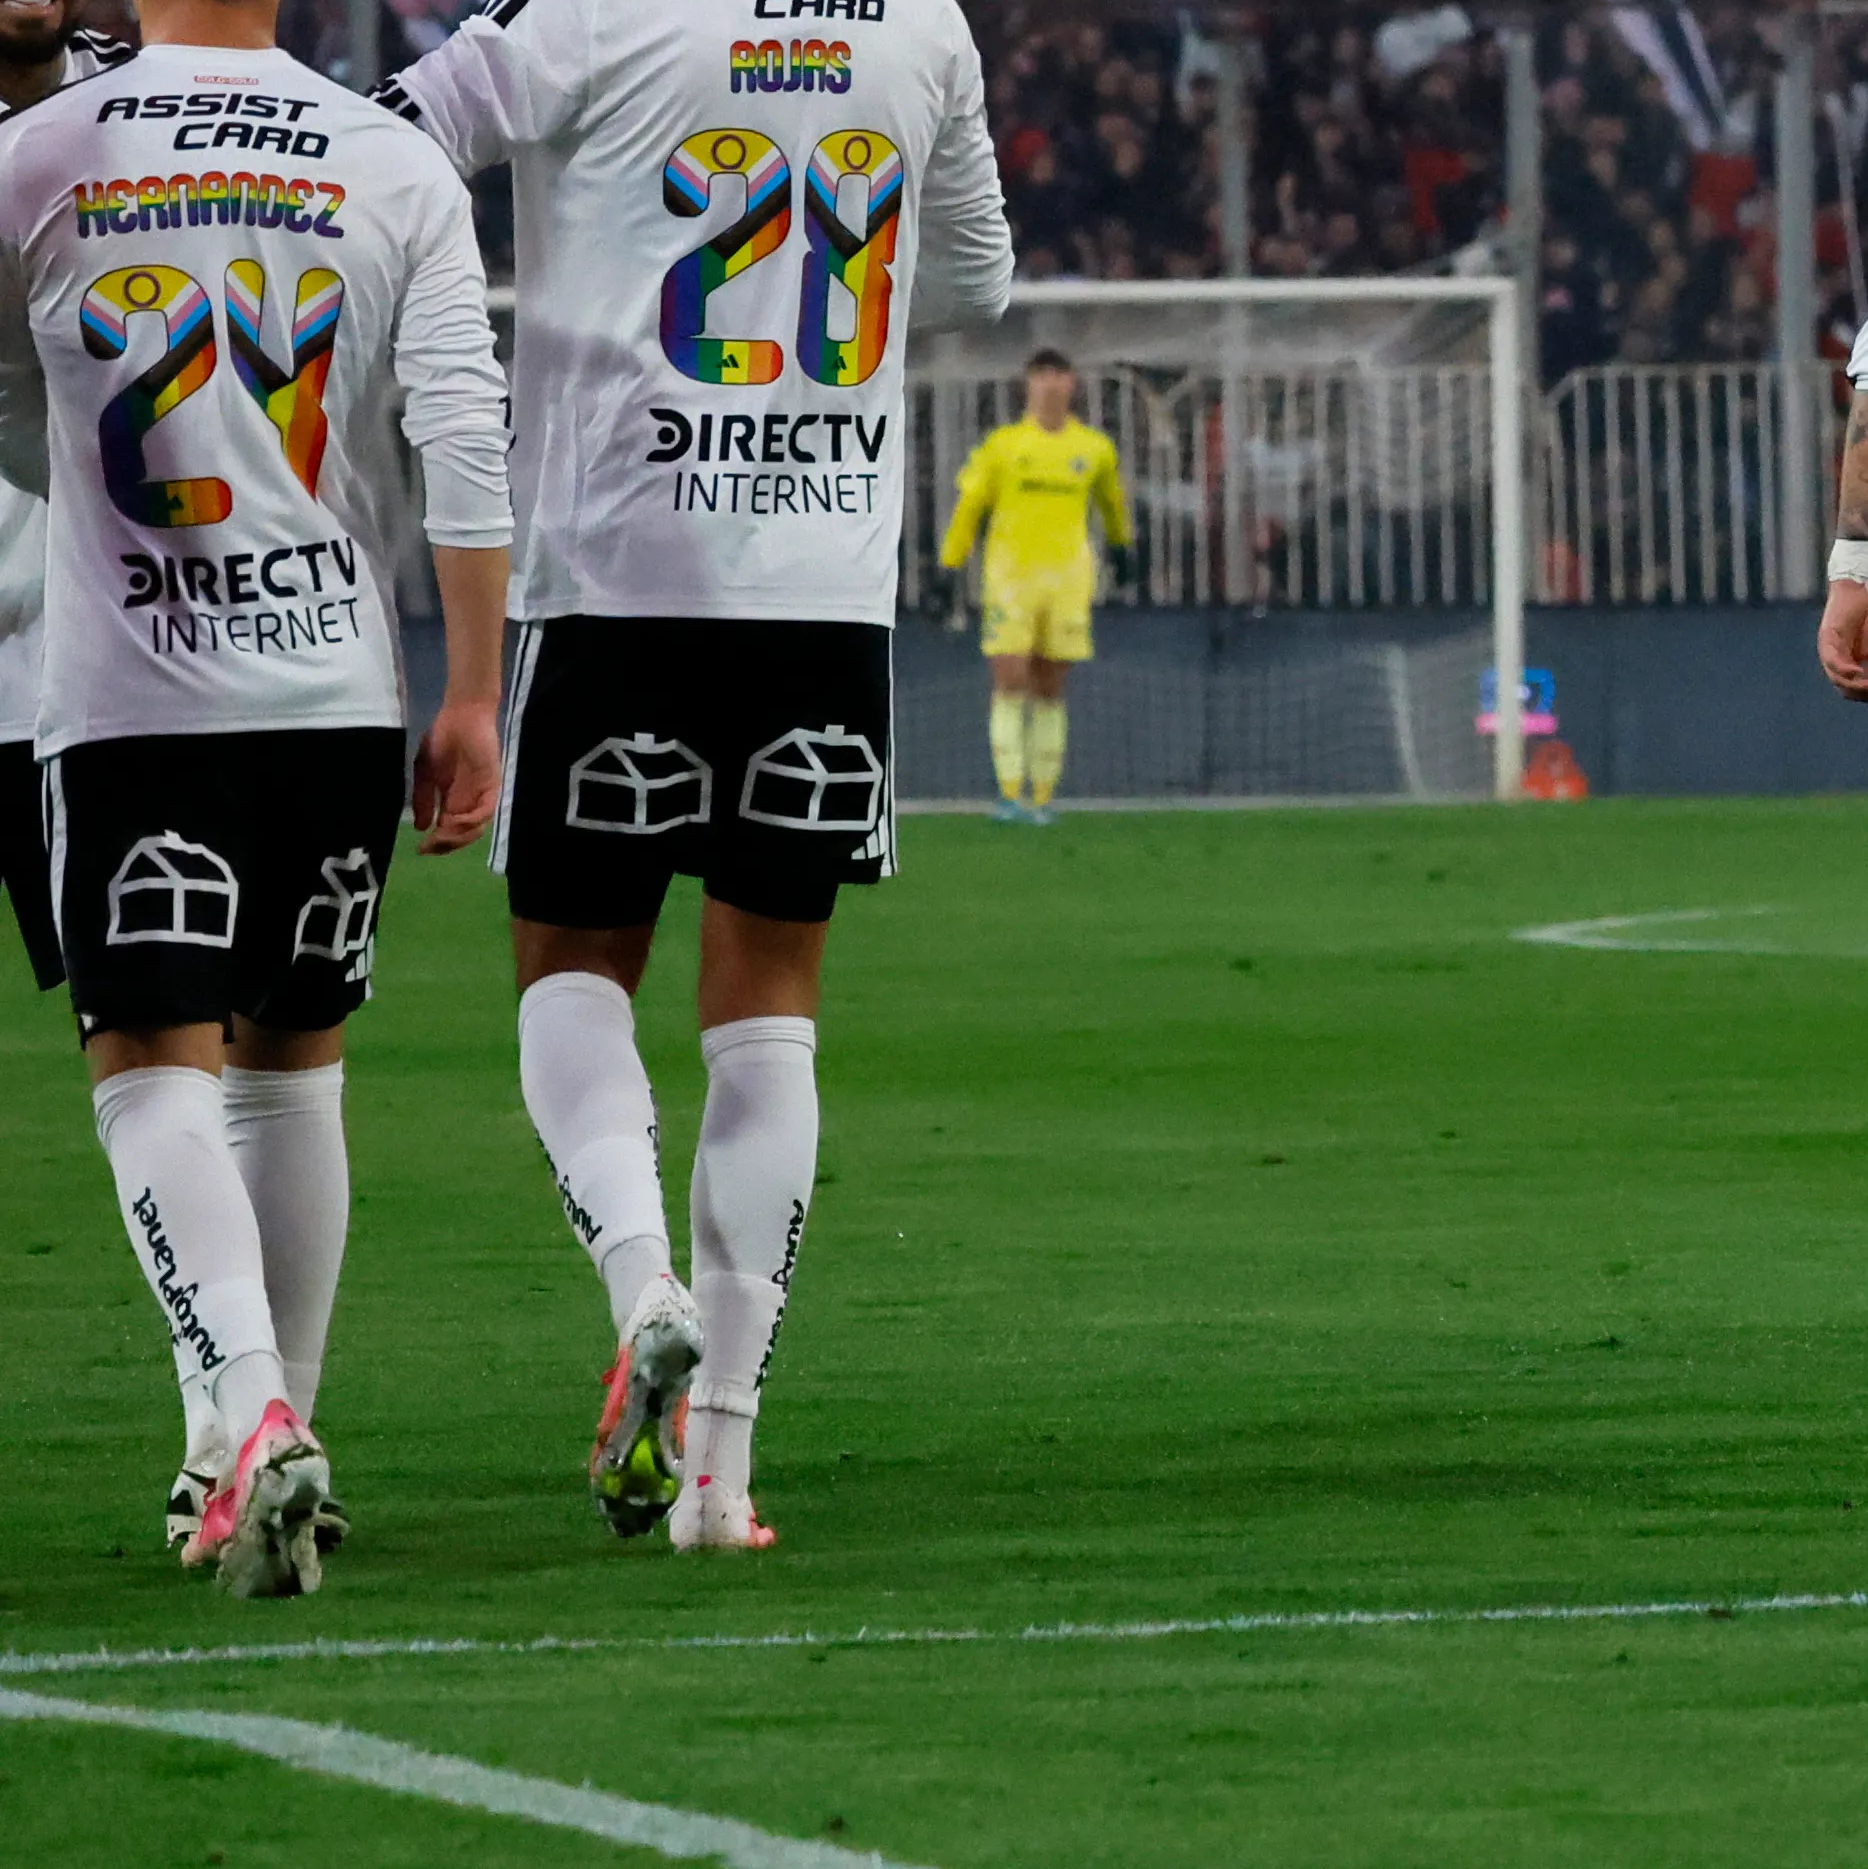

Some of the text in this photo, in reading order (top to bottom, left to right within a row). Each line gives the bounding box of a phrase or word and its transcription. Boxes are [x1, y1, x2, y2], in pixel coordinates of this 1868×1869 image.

[730, 39, 852, 94] ROJAS
[97, 93, 319, 124] ASSIST
[173, 122, 330, 159] CARD
[74, 171, 346, 239] HERNANDEZ
[659, 128, 904, 387] 28
[80, 258, 346, 528] 24
[646, 408, 888, 464] DIRECTV
[674, 472, 879, 514] INTERNET
[122, 536, 359, 609] DIRECTV
[153, 596, 360, 655] INTERNET
